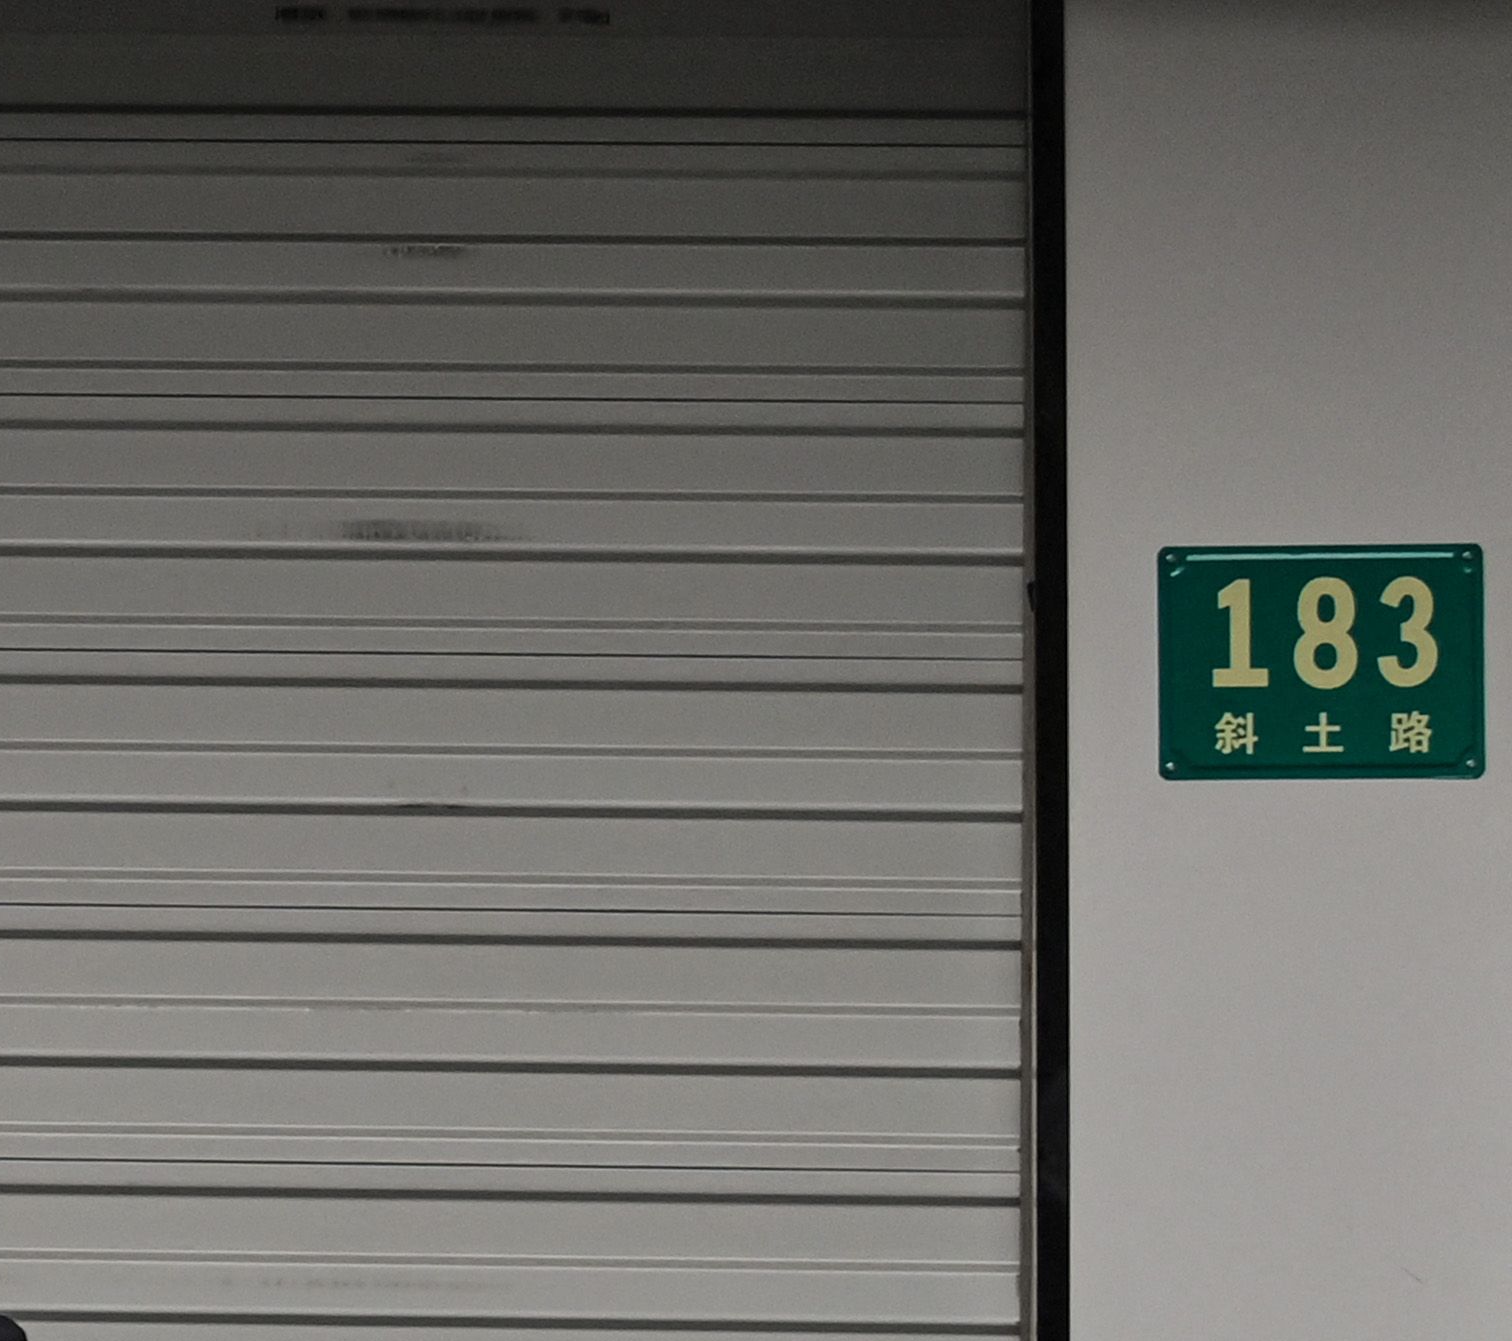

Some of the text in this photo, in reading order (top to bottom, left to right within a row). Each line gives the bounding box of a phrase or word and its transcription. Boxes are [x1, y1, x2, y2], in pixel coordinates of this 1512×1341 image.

[1212, 576, 1439, 690] 183
[1214, 711, 1433, 754] 斜土路
